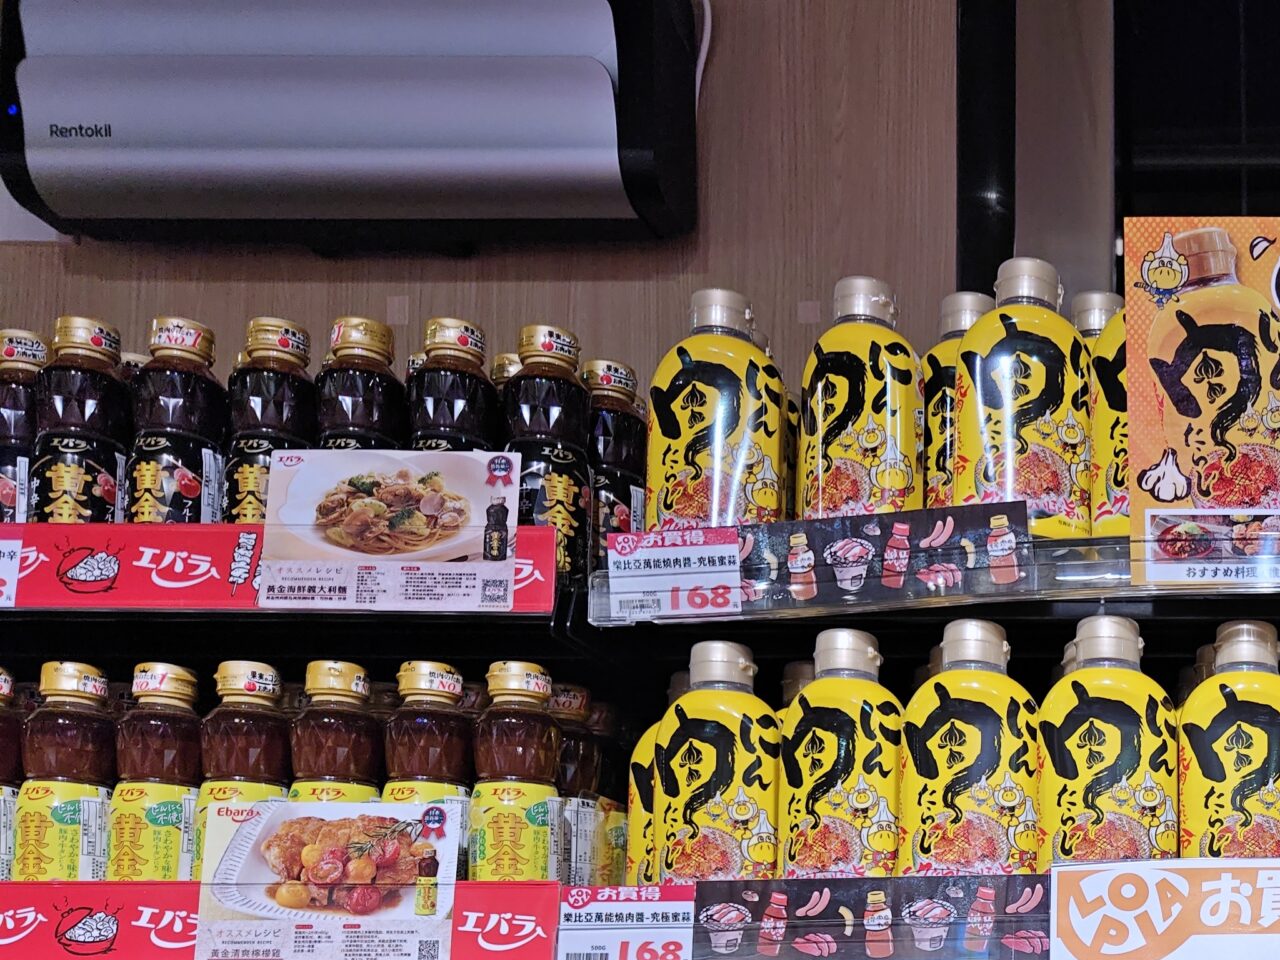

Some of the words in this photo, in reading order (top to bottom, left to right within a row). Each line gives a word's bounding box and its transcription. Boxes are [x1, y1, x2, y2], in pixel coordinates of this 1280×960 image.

[49, 123, 112, 138] Rentokil
[50, 438, 92, 453] エバラ
[641, 530, 705, 547] お買得
[132, 546, 221, 588] エバラ
[613, 555, 738, 571] 樂比亞萬能燒肉醬-究極蜜蒜
[1186, 566, 1257, 579] おすすめ料理
[670, 585, 731, 610] 168
[24, 787, 56, 802] エバラ
[217, 807, 261, 823] Ebara
[597, 886, 661, 901] お買得
[563, 912, 692, 923] 樂比亞萬能燒肉醬-究極蜜蒜
[217, 929, 281, 938] オススメレシピ
